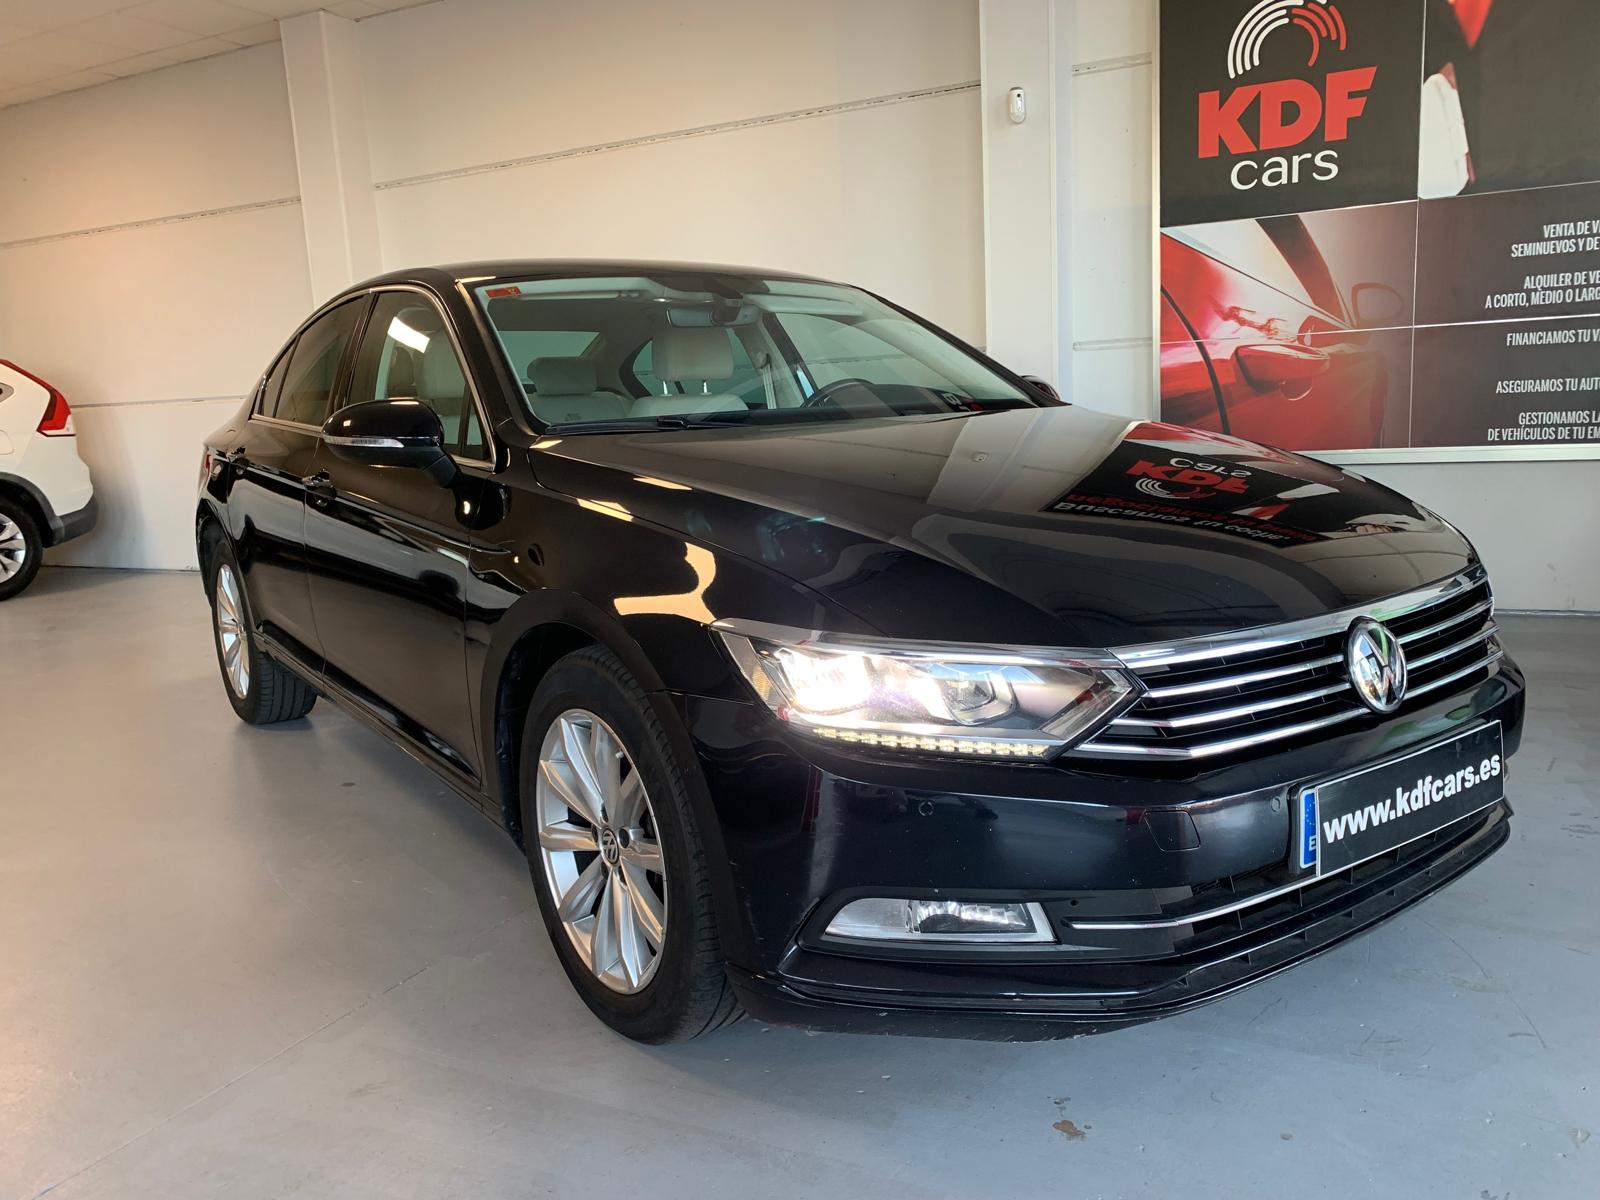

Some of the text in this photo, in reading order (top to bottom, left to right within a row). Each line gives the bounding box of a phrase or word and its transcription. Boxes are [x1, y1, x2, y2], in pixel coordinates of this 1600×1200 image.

[1198, 66, 1378, 159] KDF
[1230, 150, 1339, 190] cars
[1543, 220, 1600, 238] VENTA DE V
[1511, 236, 1600, 258] SEMINUEVOS Y DE
[1523, 272, 1572, 290] ALQUILER
[1573, 271, 1587, 285] DE
[1485, 286, 1600, 309] A CORTO, MEDIO O LARG
[1506, 328, 1600, 346] FINANCIAMOS TU V
[1496, 377, 1600, 394] ASEGURAMOS TU AUT
[1518, 410, 1590, 425] GESTIONAMOS
[1487, 428, 1500, 441] DE
[1501, 425, 1556, 441] VEHÍCULOS
[1557, 426, 1571, 440] DE
[1572, 426, 1586, 439] TU
[1323, 754, 1501, 844] www.kdfcars.es
